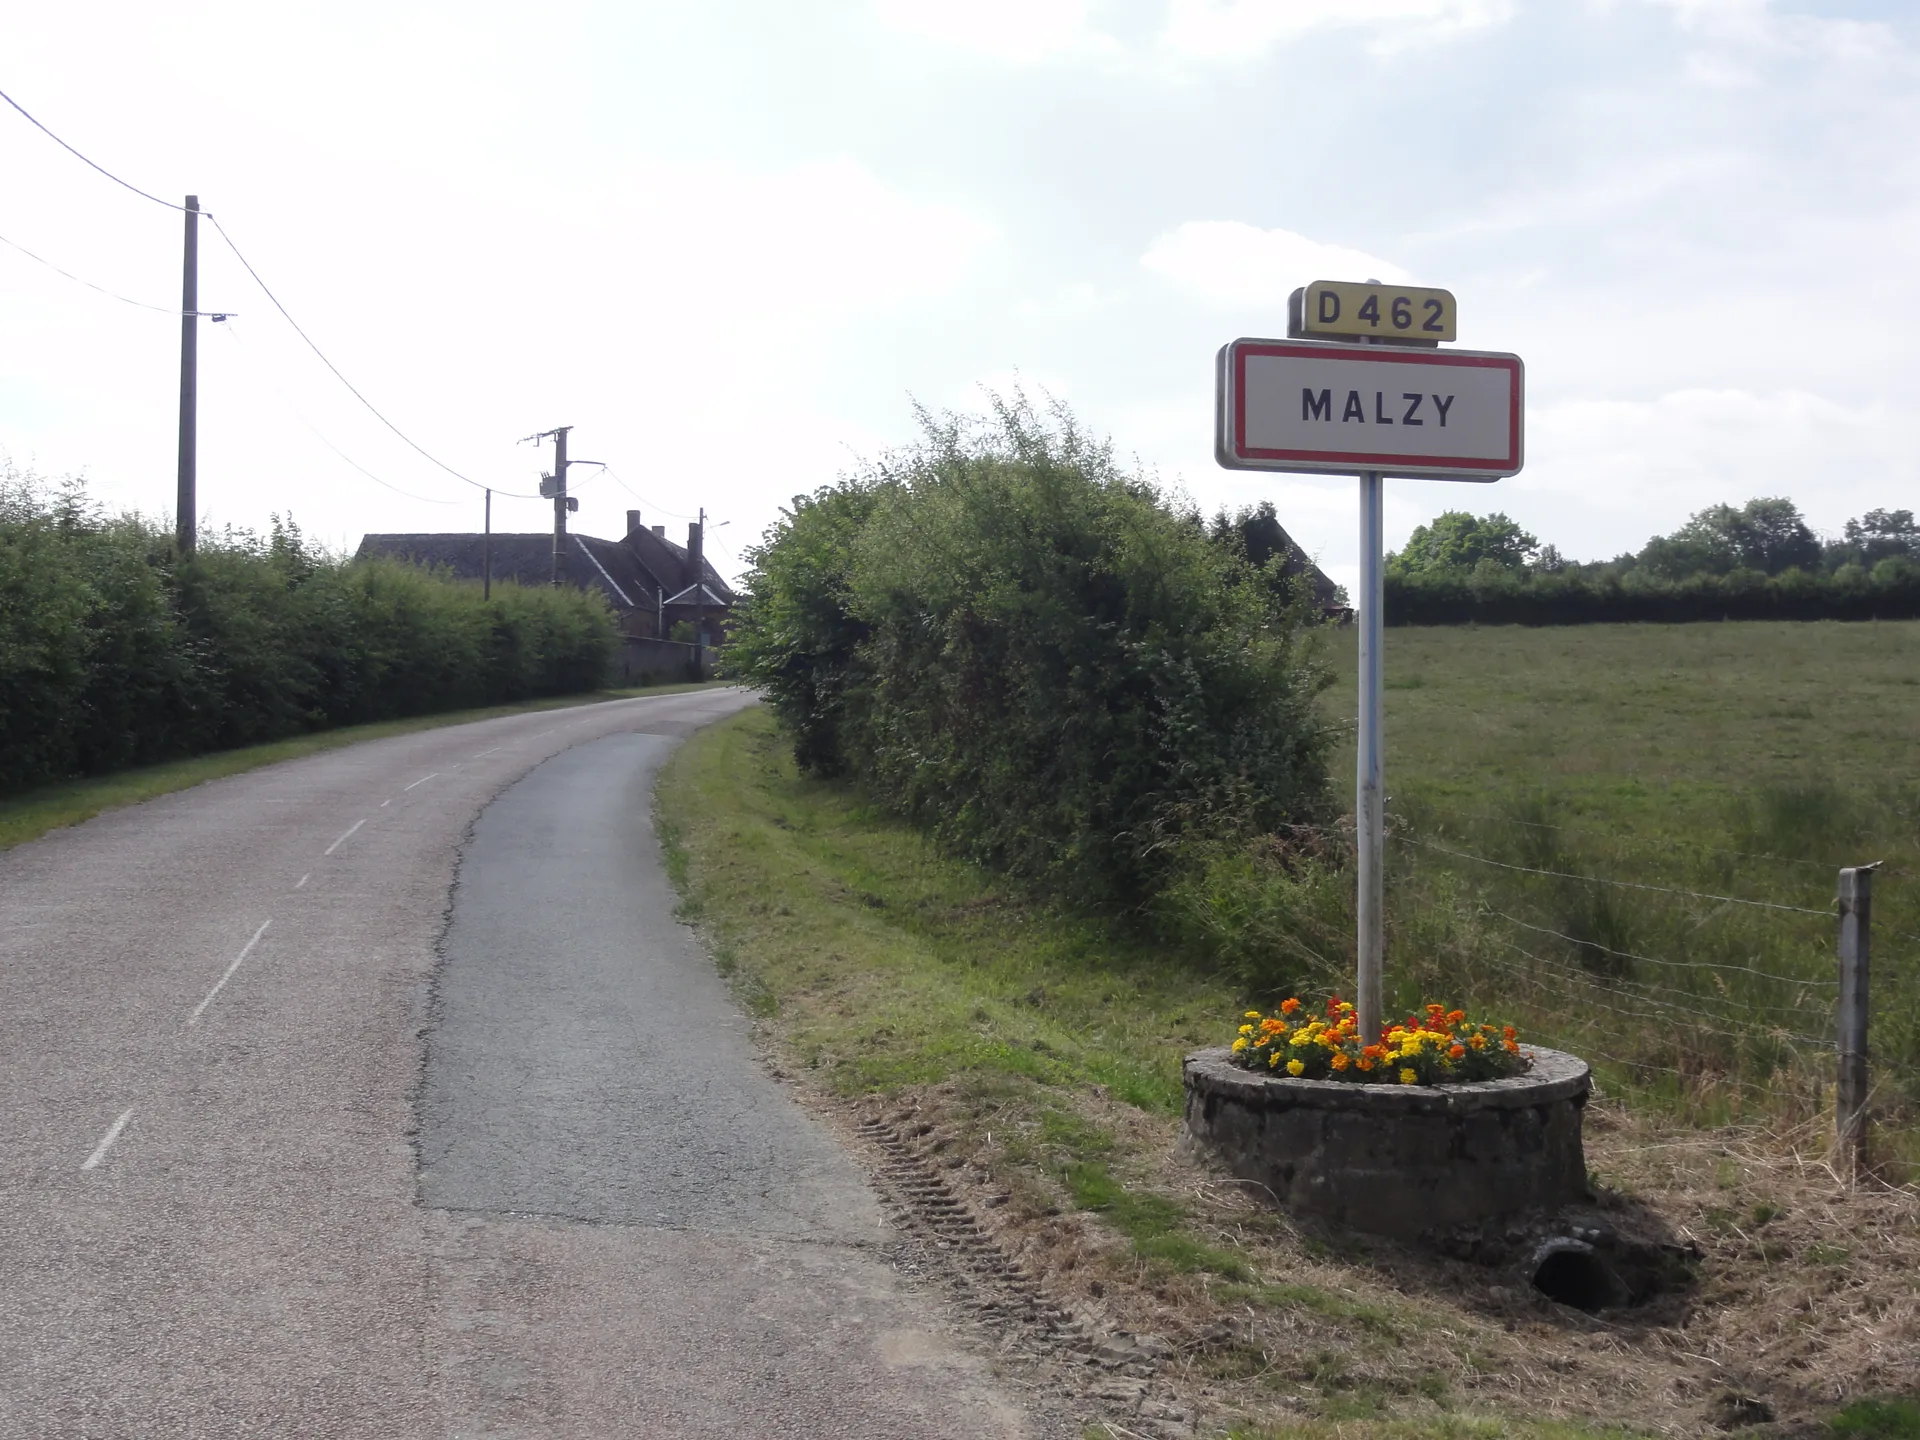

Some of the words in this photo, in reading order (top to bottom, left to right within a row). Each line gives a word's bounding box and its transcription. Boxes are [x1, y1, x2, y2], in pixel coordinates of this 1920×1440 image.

[1318, 290, 1340, 324] D
[1357, 294, 1444, 332] 462
[1302, 388, 1455, 427] MALZY
